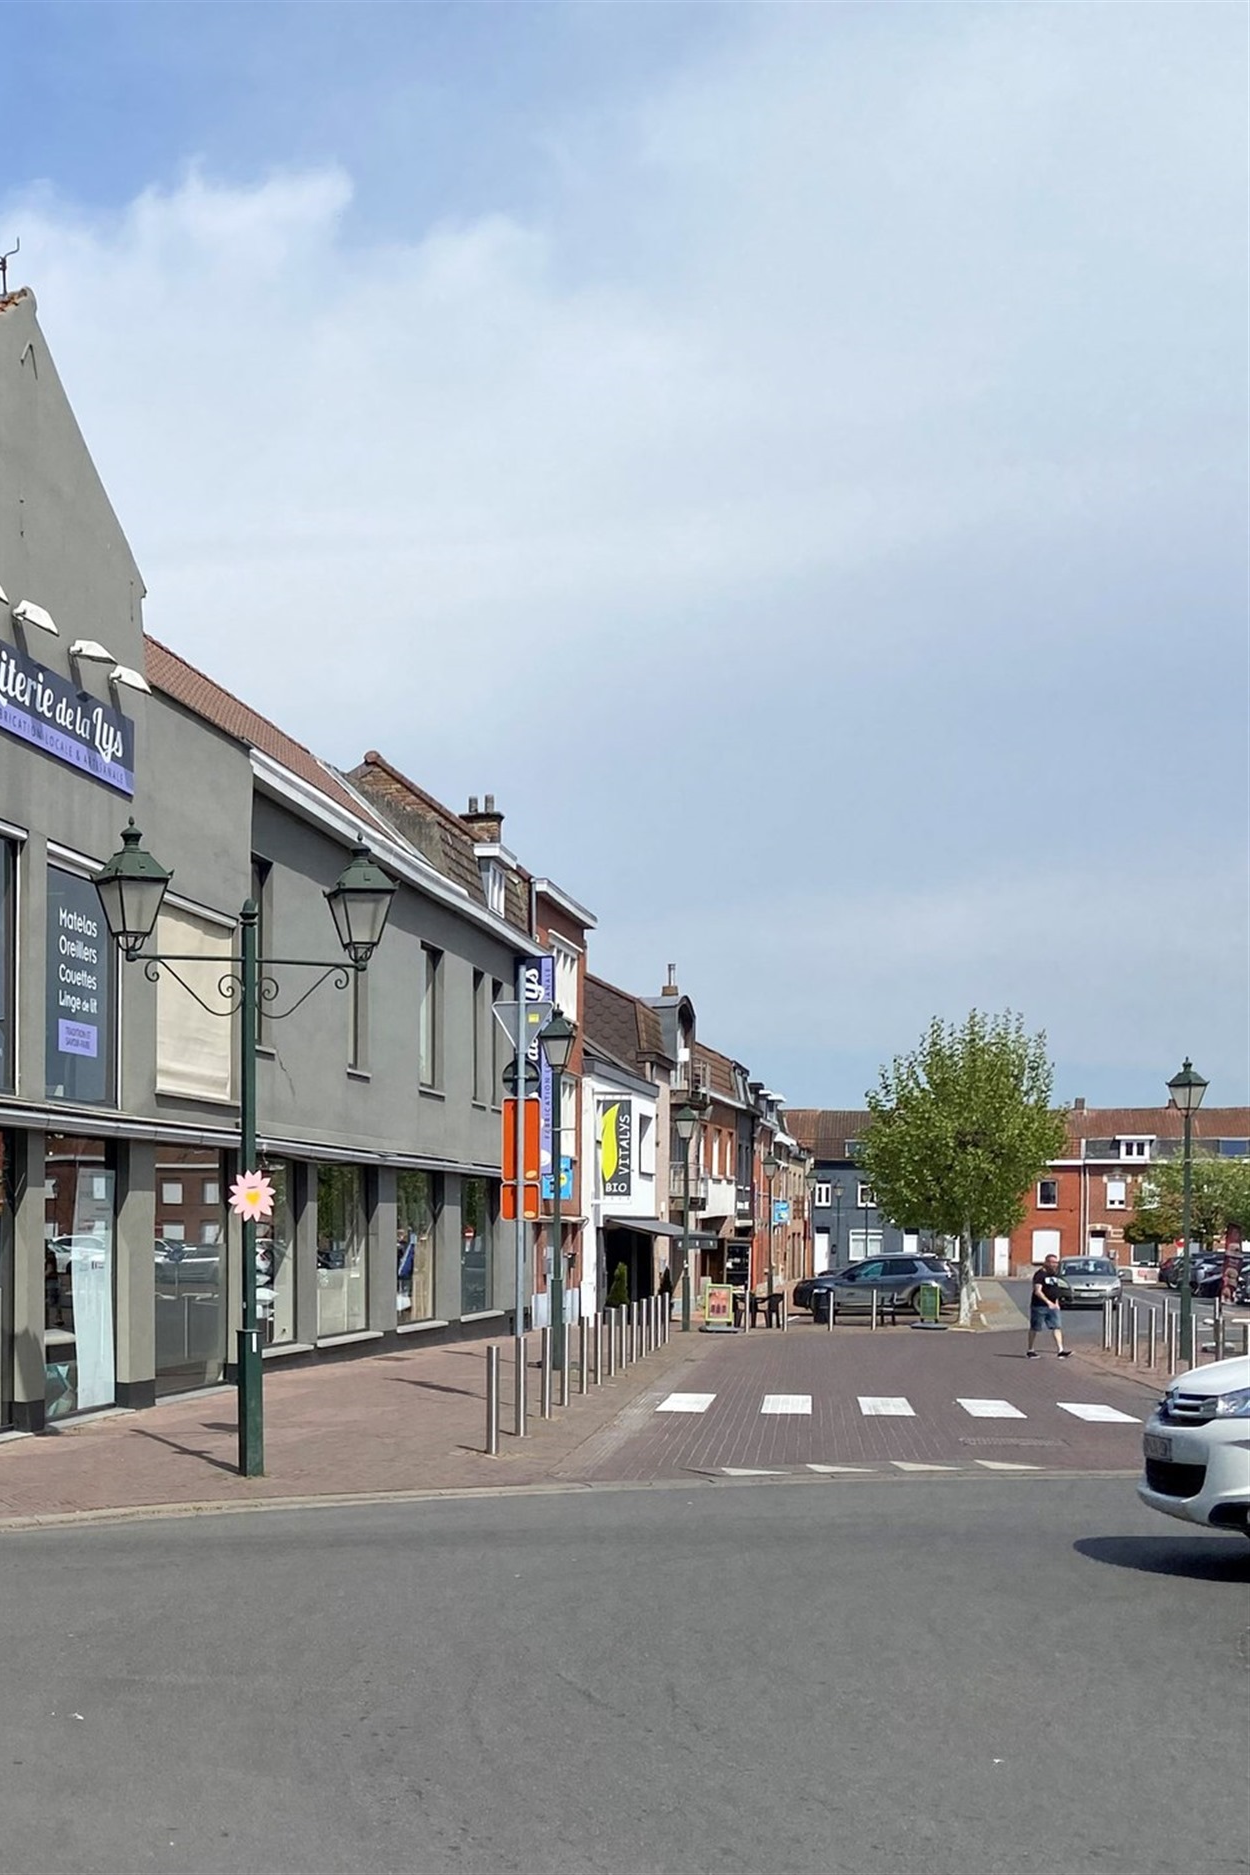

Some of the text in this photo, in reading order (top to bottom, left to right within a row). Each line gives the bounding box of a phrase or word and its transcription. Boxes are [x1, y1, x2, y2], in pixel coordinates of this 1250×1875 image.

[56, 697, 74, 730] de
[75, 706, 90, 740] la
[92, 707, 123, 763] Lys
[45, 736, 73, 758] LOCALE
[84, 754, 124, 784] ARTISANALE
[59, 906, 97, 938] Matelas
[59, 934, 97, 964] Oreillers
[59, 963, 97, 990] Couettes
[58, 989, 81, 1013] Linge
[81, 999, 89, 1013] de
[618, 1114, 630, 1175] VITALYS
[605, 1182, 627, 1193] BIO
